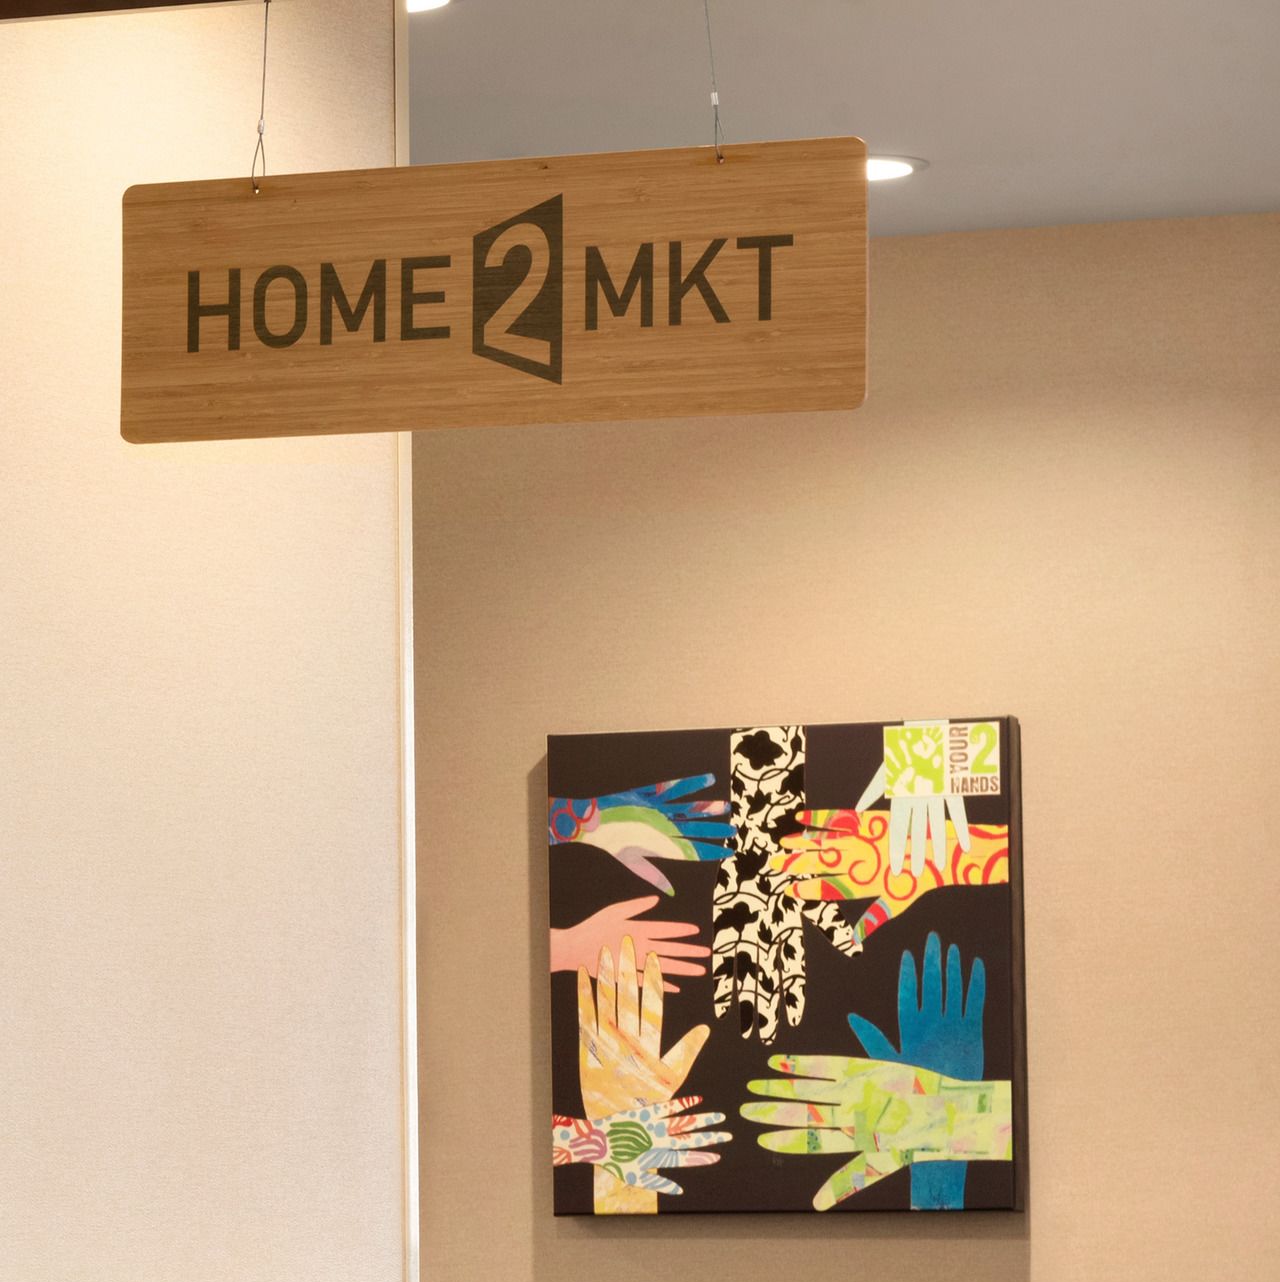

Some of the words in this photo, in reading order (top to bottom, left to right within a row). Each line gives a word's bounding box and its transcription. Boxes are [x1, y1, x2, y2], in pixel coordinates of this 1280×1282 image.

[948, 726, 969, 774] YOUR
[969, 723, 998, 774] 2
[950, 775, 999, 794] HANDS
